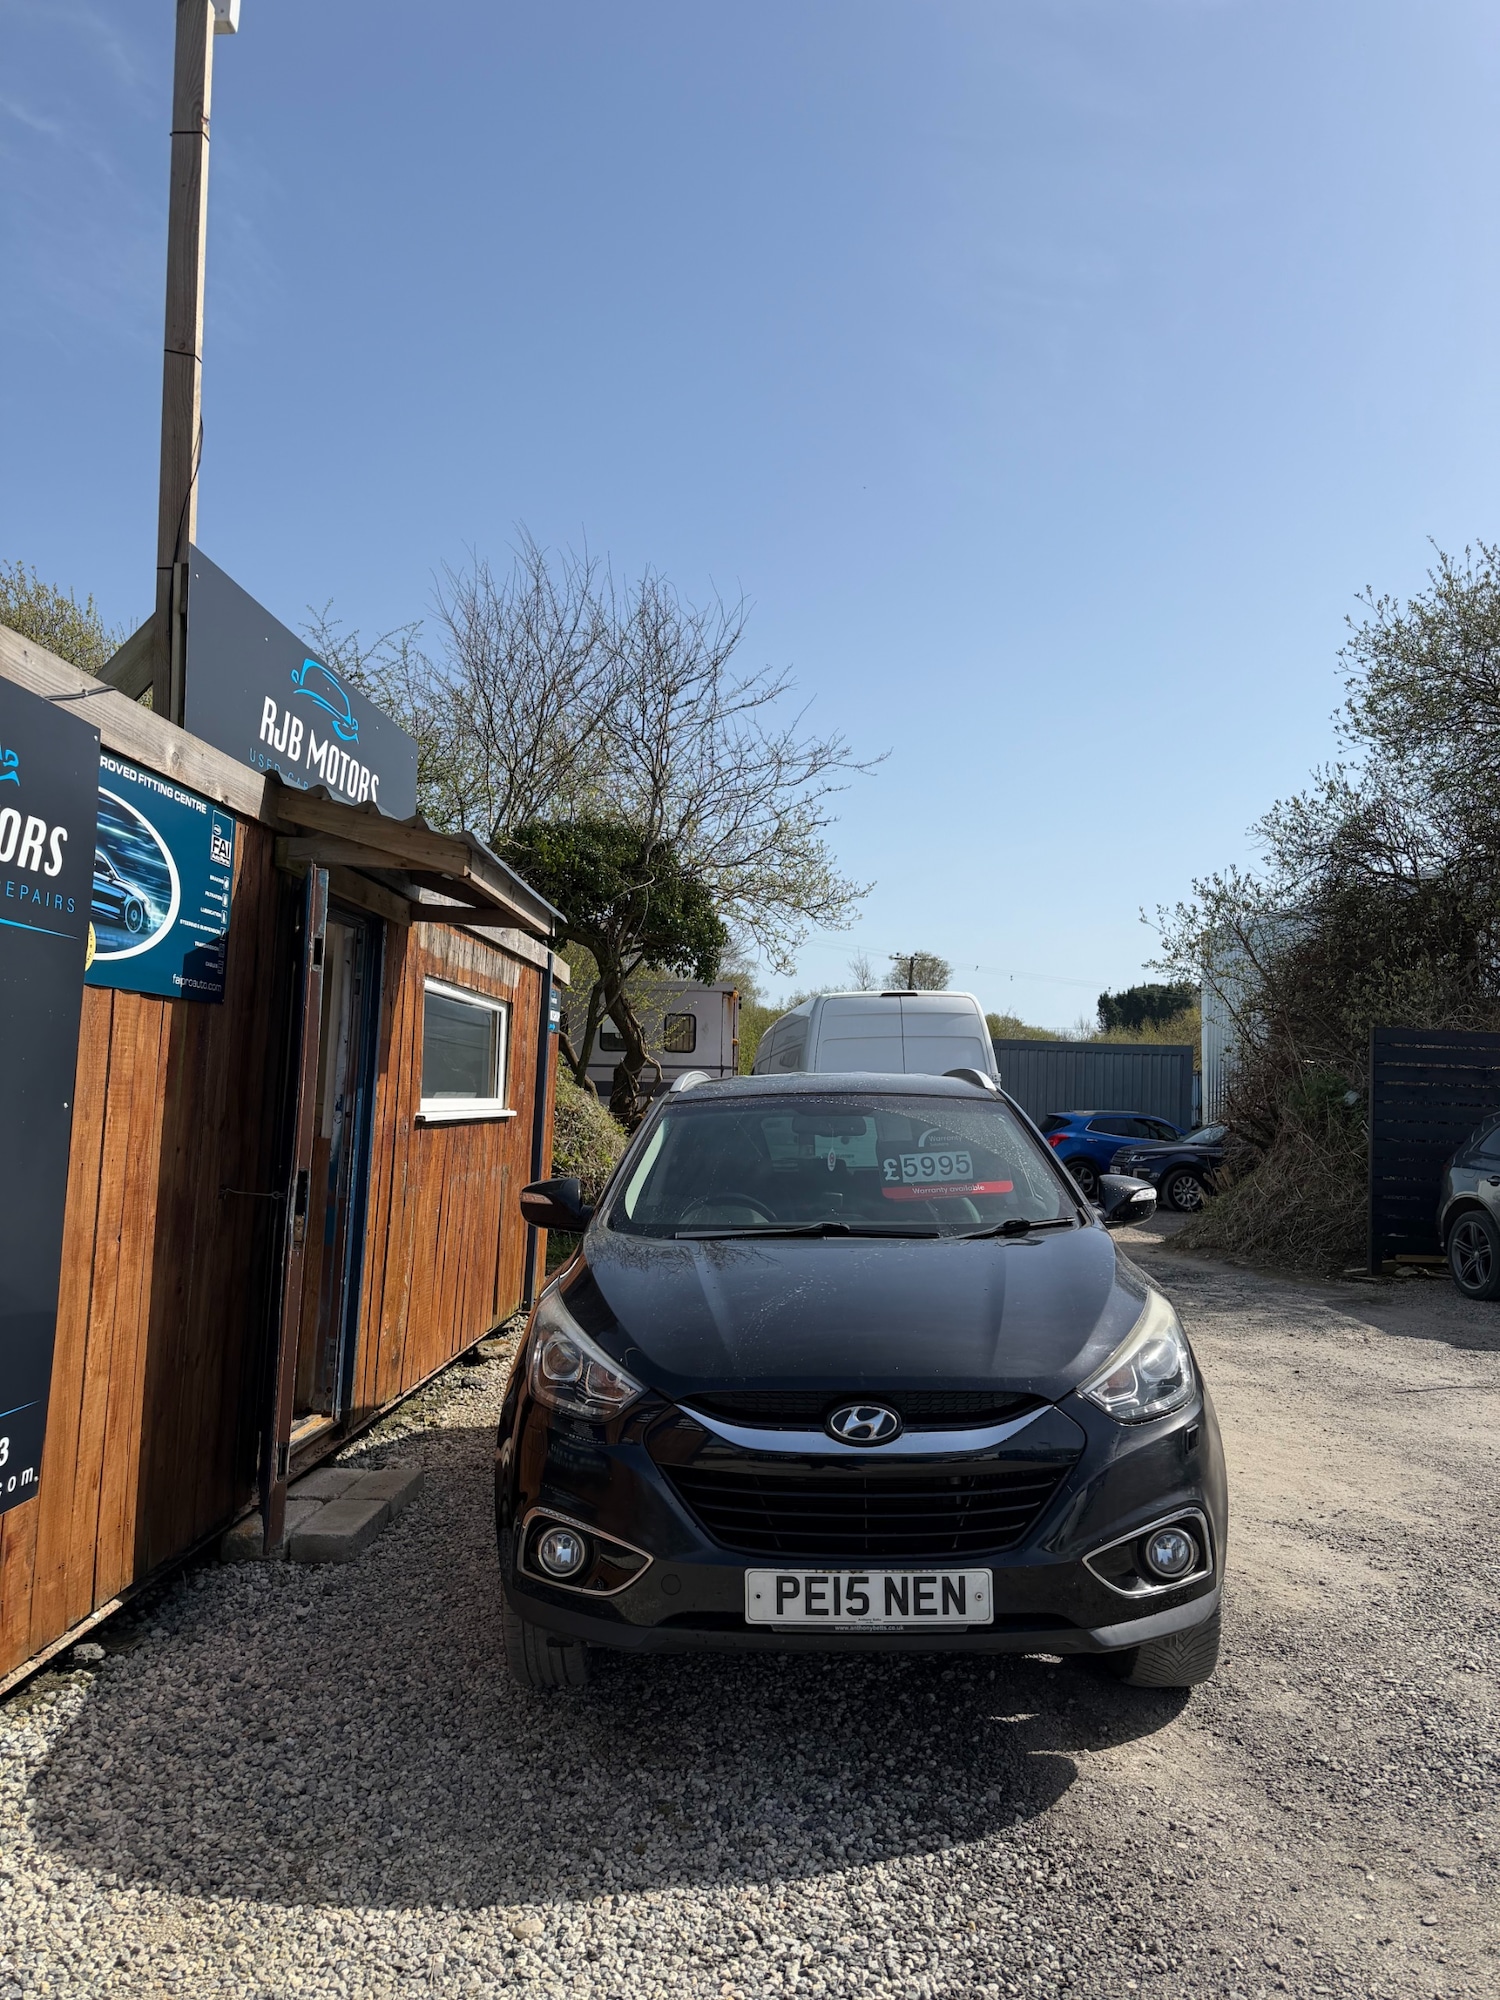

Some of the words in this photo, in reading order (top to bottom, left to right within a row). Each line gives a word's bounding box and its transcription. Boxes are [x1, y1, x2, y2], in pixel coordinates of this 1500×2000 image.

[260, 695, 304, 762] RJB
[306, 729, 379, 803] MOTORS
[138, 773, 174, 799] FITTING
[174, 790, 207, 815] CENTRE
[212, 836, 231, 858] FAI
[0, 880, 76, 913] EPAIRS
[172, 973, 222, 992] faiproauto.com
[928, 1134, 962, 1142] Warranty
[882, 1154, 971, 1182] £5995
[912, 1185, 949, 1195] Warranty
[949, 1183, 985, 1194] available
[775, 1576, 870, 1617] PE15
[884, 1576, 966, 1617] NEN
